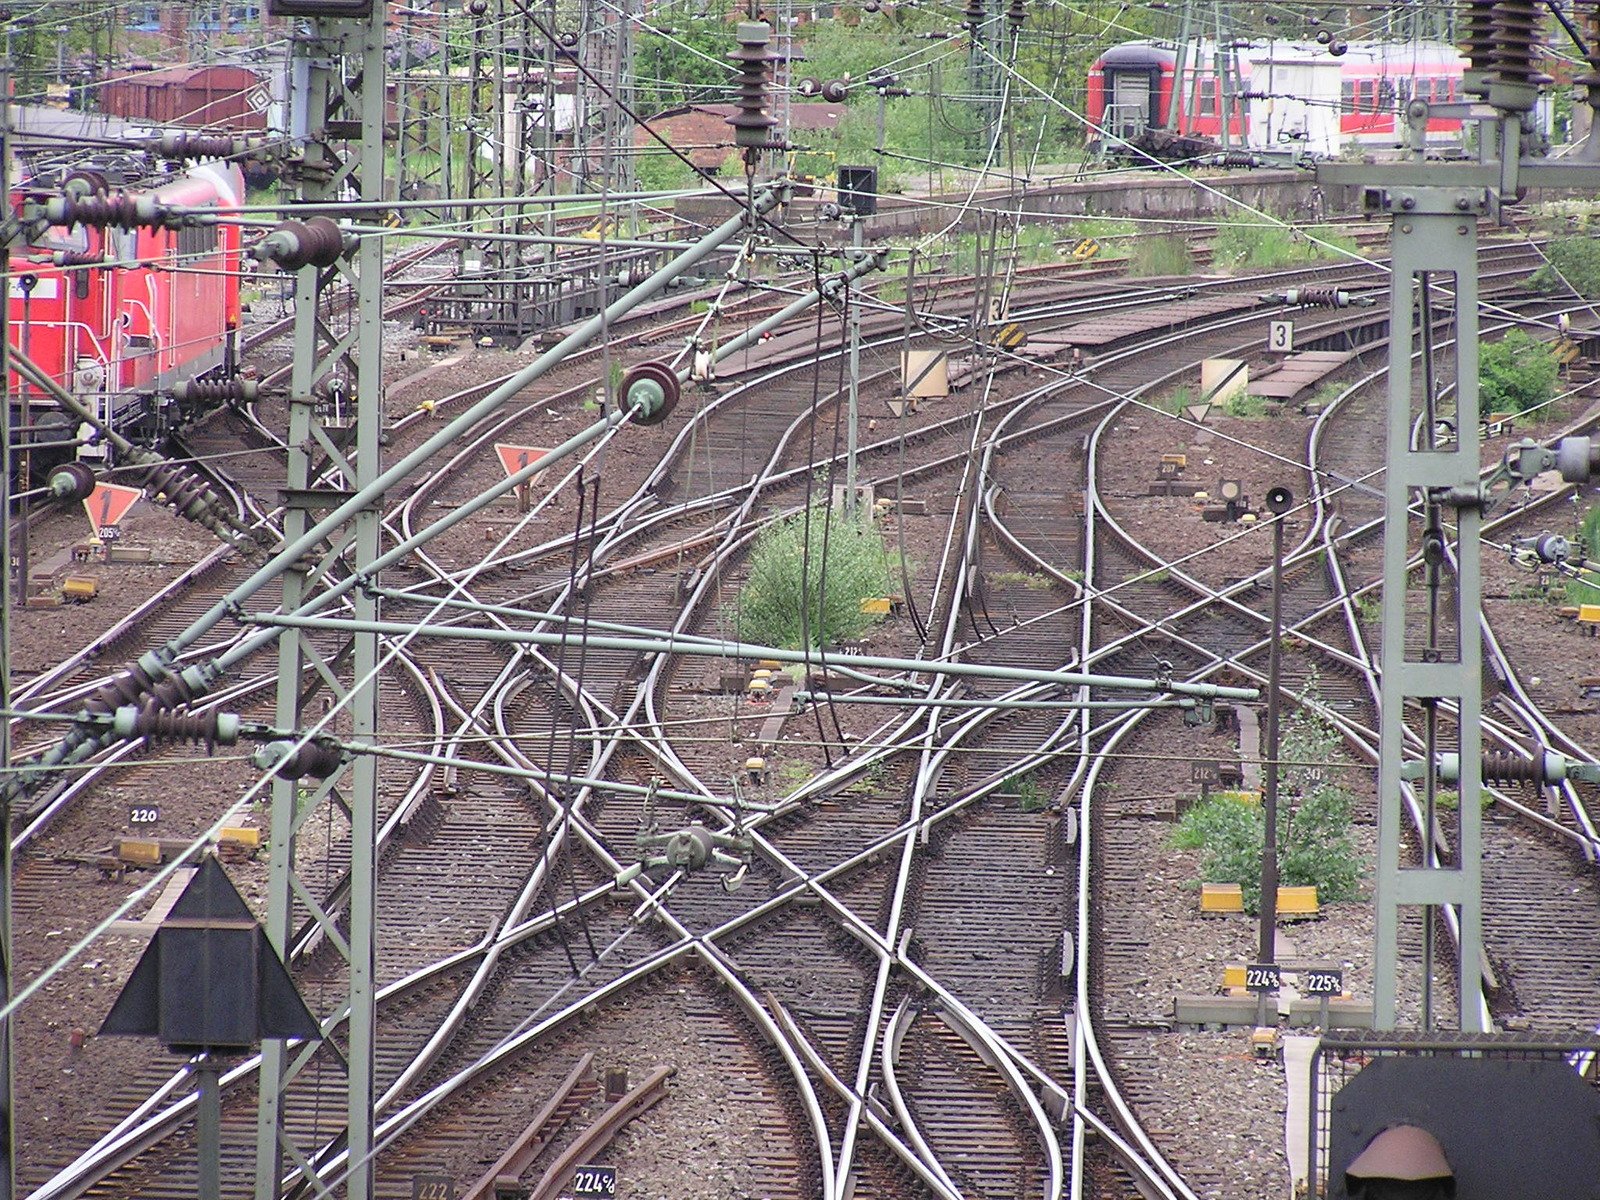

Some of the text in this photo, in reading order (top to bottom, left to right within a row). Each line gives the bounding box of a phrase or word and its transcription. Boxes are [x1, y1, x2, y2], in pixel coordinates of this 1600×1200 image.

[1276, 324, 1286, 347] 3
[101, 490, 111, 524] 1
[131, 809, 157, 822] 220
[418, 1183, 447, 1200] 222
